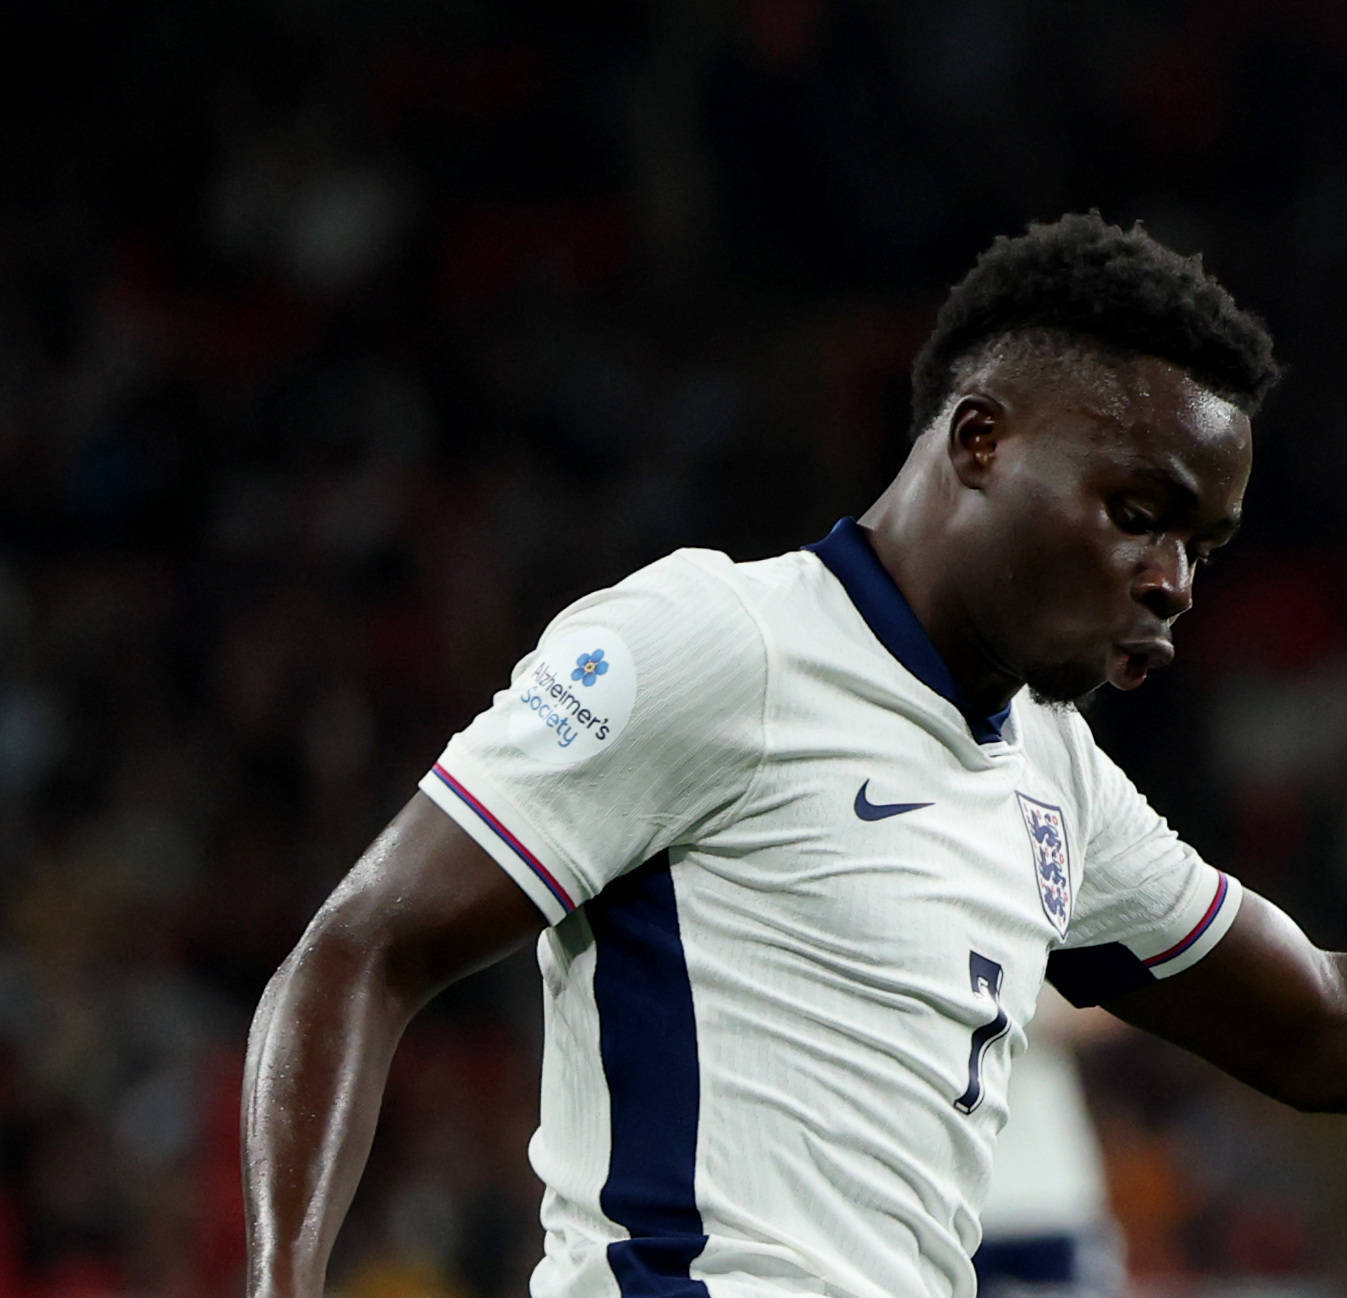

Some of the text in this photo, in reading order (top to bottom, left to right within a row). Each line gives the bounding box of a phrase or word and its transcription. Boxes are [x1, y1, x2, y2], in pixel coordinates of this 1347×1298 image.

[520, 685, 579, 748] Society
[533, 661, 611, 741] Alzheimer's
[953, 949, 1013, 1116] 7
